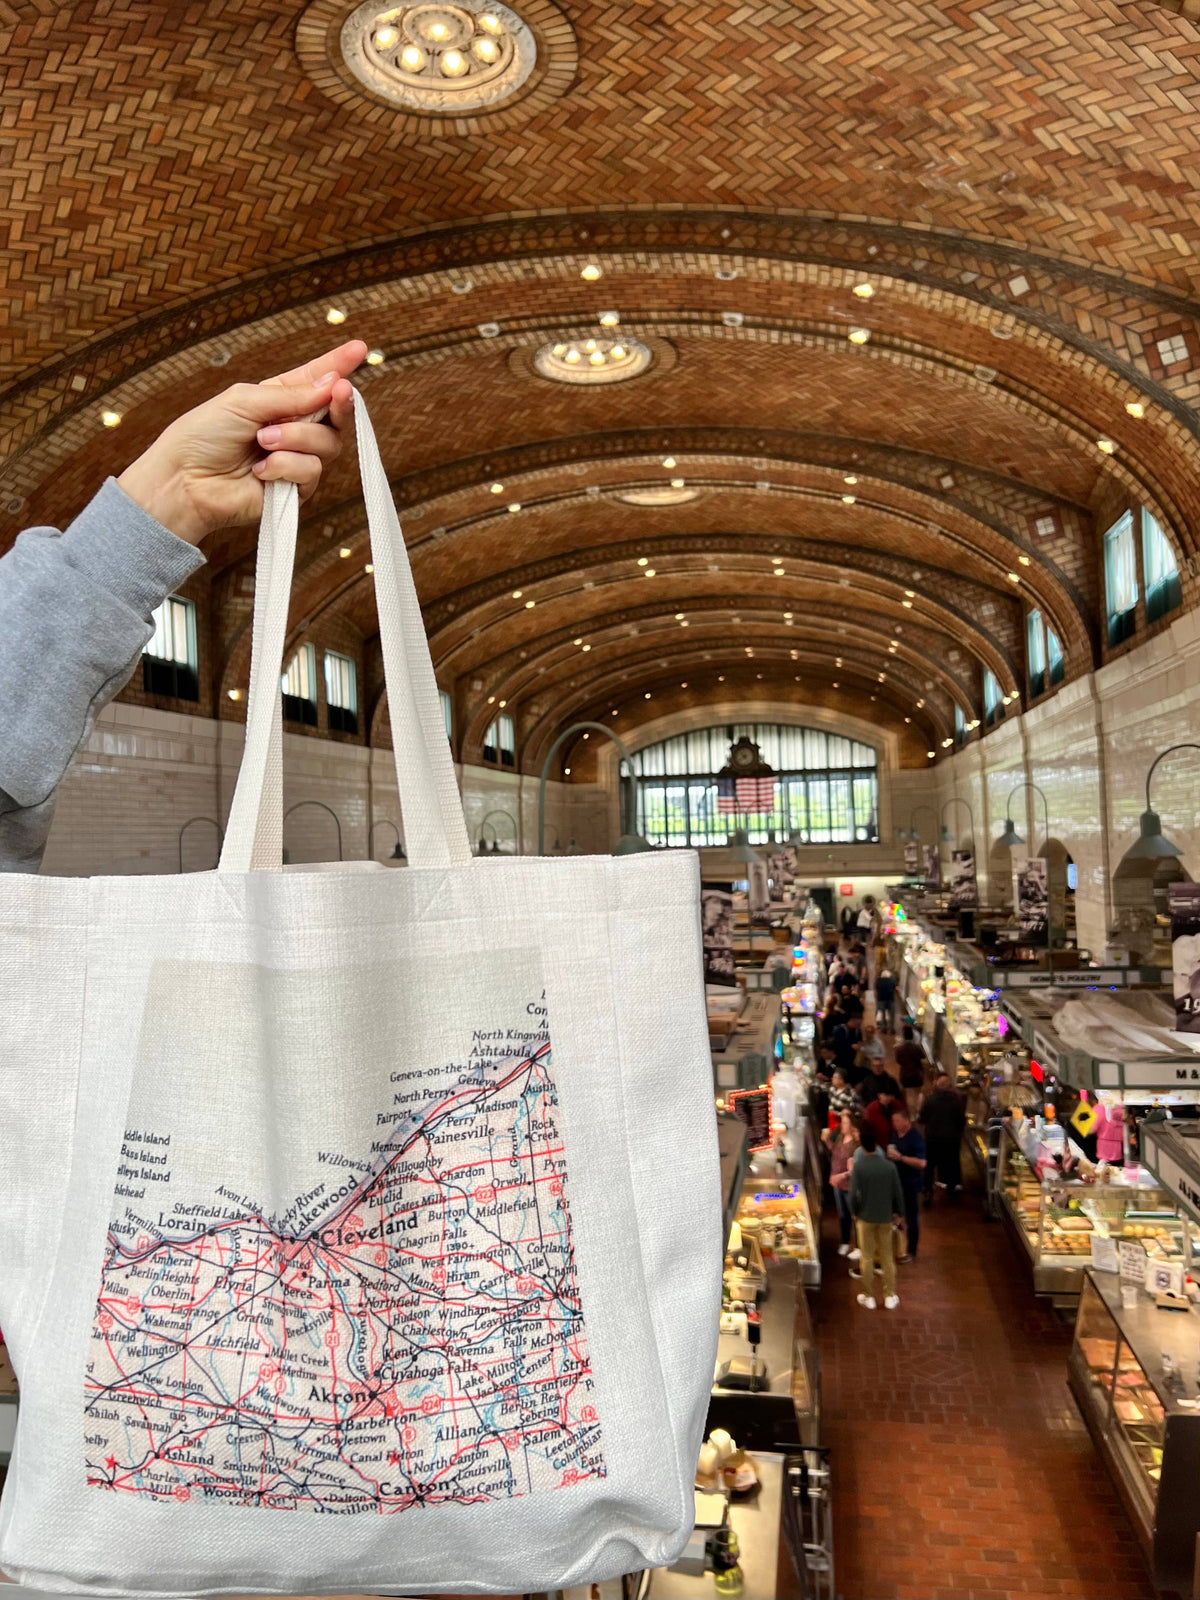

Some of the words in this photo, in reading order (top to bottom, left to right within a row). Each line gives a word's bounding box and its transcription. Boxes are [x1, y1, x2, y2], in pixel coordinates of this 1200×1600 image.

[472, 1029, 503, 1041] North
[468, 1045, 531, 1058] Ashtabula
[390, 1059, 492, 1082] Geneva-on-the-Lake
[1176, 1069, 1187, 1079] M
[458, 1074, 496, 1088] Geneva
[393, 1090, 421, 1105] North
[422, 1089, 452, 1100] Perry
[474, 1100, 518, 1115] Madison
[376, 1109, 412, 1126] Fairport
[446, 1116, 476, 1127] Perry
[531, 1118, 555, 1131] Rock
[143, 1132, 171, 1146] Island
[426, 1125, 495, 1145] Painesville
[530, 1129, 559, 1142] Creek
[120, 1144, 138, 1160] Bass
[139, 1150, 168, 1165] Island
[370, 1142, 403, 1153] Mentor
[508, 1126, 518, 1167] Grand
[317, 1152, 373, 1173] Willowick
[389, 1157, 443, 1176] Willoughby
[140, 1167, 171, 1182] Island
[441, 1168, 485, 1181] Chardon
[491, 1173, 526, 1189] Orwell
[215, 1185, 240, 1203] Avon
[241, 1196, 263, 1215] Lake
[295, 1183, 325, 1210] River
[369, 1187, 403, 1208] Euclid
[393, 1201, 420, 1213] Gates
[421, 1194, 447, 1206] Mills
[172, 1202, 221, 1218] Sheffield
[222, 1207, 247, 1220] Lake
[290, 1175, 359, 1237] Lakewood
[428, 1208, 465, 1221] Burton
[476, 1196, 537, 1218] Middlefield
[124, 1207, 164, 1240] Vermilion
[158, 1212, 207, 1232] Lorain
[321, 1212, 419, 1247] Cleveland
[231, 1226, 242, 1266] Black
[253, 1235, 273, 1247] Avon
[398, 1232, 440, 1250] Chagrin
[443, 1227, 467, 1241] Falls
[527, 1242, 570, 1254] Cortland
[150, 1253, 193, 1267] Amherst
[387, 1256, 414, 1271] Solon
[421, 1258, 445, 1269] West
[447, 1247, 511, 1265] Farmington
[130, 1265, 159, 1281] Berlin
[161, 1270, 200, 1287] Heights
[214, 1275, 252, 1293] Elyria
[308, 1276, 351, 1289] Parma
[359, 1276, 400, 1292] Bedford
[446, 1270, 480, 1283] Hiram
[479, 1259, 544, 1292] Garrettsville
[104, 1281, 129, 1296] Milan
[151, 1285, 190, 1301] Oberlin
[283, 1283, 313, 1300] Berea
[407, 1273, 445, 1297] Mantua
[262, 1297, 308, 1319] Strongsville
[365, 1295, 420, 1309] Northfield
[171, 1303, 220, 1321] Lagrange
[236, 1309, 274, 1326] Grafton
[393, 1309, 430, 1326] Hudson
[438, 1305, 491, 1321] Windham
[475, 1300, 540, 1331] Leavittsburg
[145, 1313, 193, 1331] Wakeman
[286, 1310, 334, 1339] Brecksville
[503, 1322, 542, 1336] Newton
[402, 1324, 468, 1340] Charlestown
[530, 1321, 581, 1349] McDonald
[206, 1335, 260, 1350] Litchfield
[356, 1311, 369, 1380] Cuyahoga
[446, 1344, 494, 1358] Ravenna
[503, 1336, 527, 1349] Falls
[127, 1344, 183, 1359] Wellington
[301, 1353, 329, 1367] Creek
[384, 1346, 414, 1361] Kent
[281, 1365, 317, 1381] Medina
[382, 1365, 444, 1381] Cuyahoga
[447, 1360, 479, 1375] Falls
[459, 1375, 484, 1391] Lake
[487, 1359, 523, 1380] Milton
[476, 1376, 517, 1400] Jackson
[519, 1353, 551, 1378] Center
[143, 1373, 164, 1386] New
[166, 1376, 204, 1392] London
[534, 1373, 577, 1394] Canfield
[108, 1388, 163, 1408] Greenwich
[256, 1385, 311, 1419] Wadsworth
[309, 1385, 366, 1403] Akron
[88, 1408, 120, 1421] Shiloh
[196, 1407, 240, 1422] Burbank
[240, 1398, 276, 1419] Seville
[500, 1398, 537, 1416] Berlin
[520, 1406, 560, 1425] Sebring
[124, 1416, 172, 1433] Savannah
[345, 1412, 417, 1431] Barberton
[226, 1433, 266, 1445] Creston
[321, 1434, 386, 1449] Doylestown
[435, 1423, 491, 1443] Alliance
[524, 1429, 561, 1446] Salem
[182, 1435, 203, 1449] Polk
[545, 1427, 588, 1459] Leetonia
[164, 1447, 214, 1466] Ashland
[293, 1440, 340, 1462] Rittman
[350, 1452, 383, 1463] Canal
[386, 1448, 424, 1462] Fulton
[223, 1460, 278, 1475] Smithville
[260, 1450, 291, 1468] North
[293, 1460, 346, 1485] Lawrence
[413, 1457, 448, 1475] North
[449, 1449, 489, 1467] Canton
[457, 1458, 511, 1480] Louisville
[581, 1453, 603, 1469] East
[141, 1468, 180, 1483] Charles
[150, 1482, 172, 1496] Mill
[203, 1485, 256, 1499] Wooster
[380, 1479, 450, 1497] Canton
[456, 1485, 475, 1498] East
[477, 1479, 517, 1493] Canton
[329, 1493, 367, 1503] Dalton
